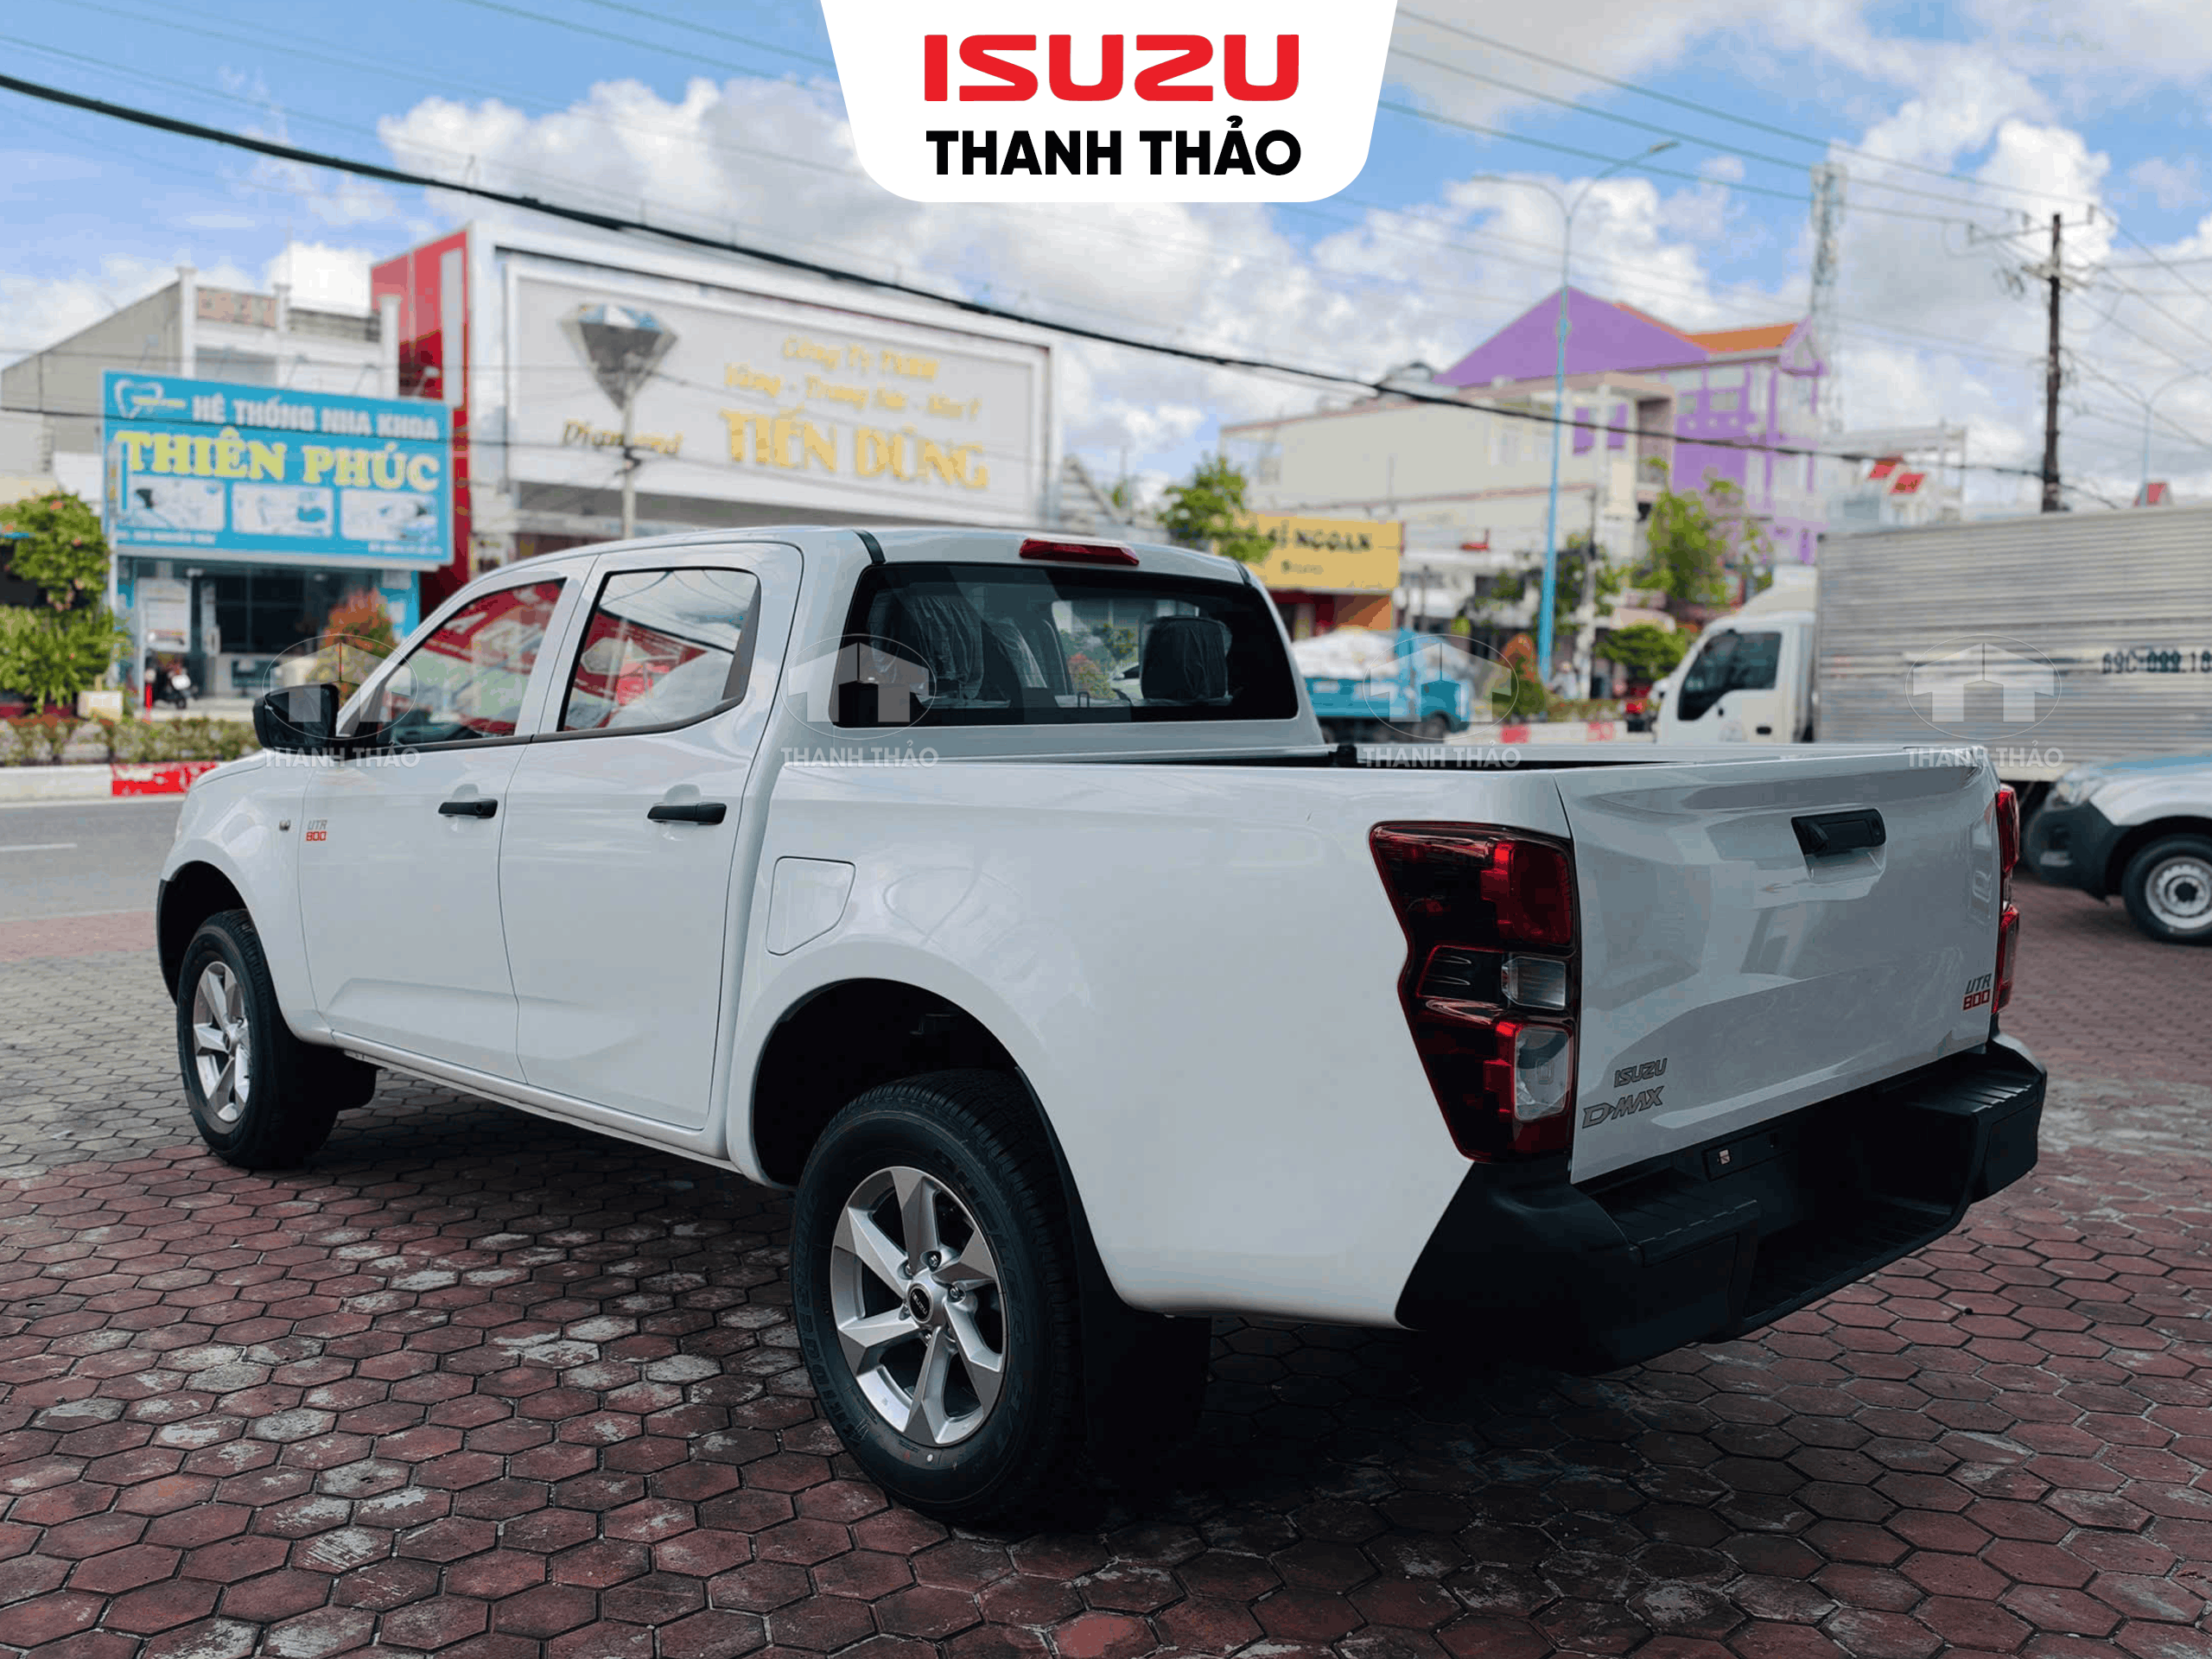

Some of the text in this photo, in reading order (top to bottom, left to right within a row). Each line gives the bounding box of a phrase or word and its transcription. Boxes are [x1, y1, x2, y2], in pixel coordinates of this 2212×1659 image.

[115, 426, 441, 493] THIÊN PHÚC
[1962, 988, 1991, 1011] 800
[1613, 1058, 1668, 1089] ISUZU
